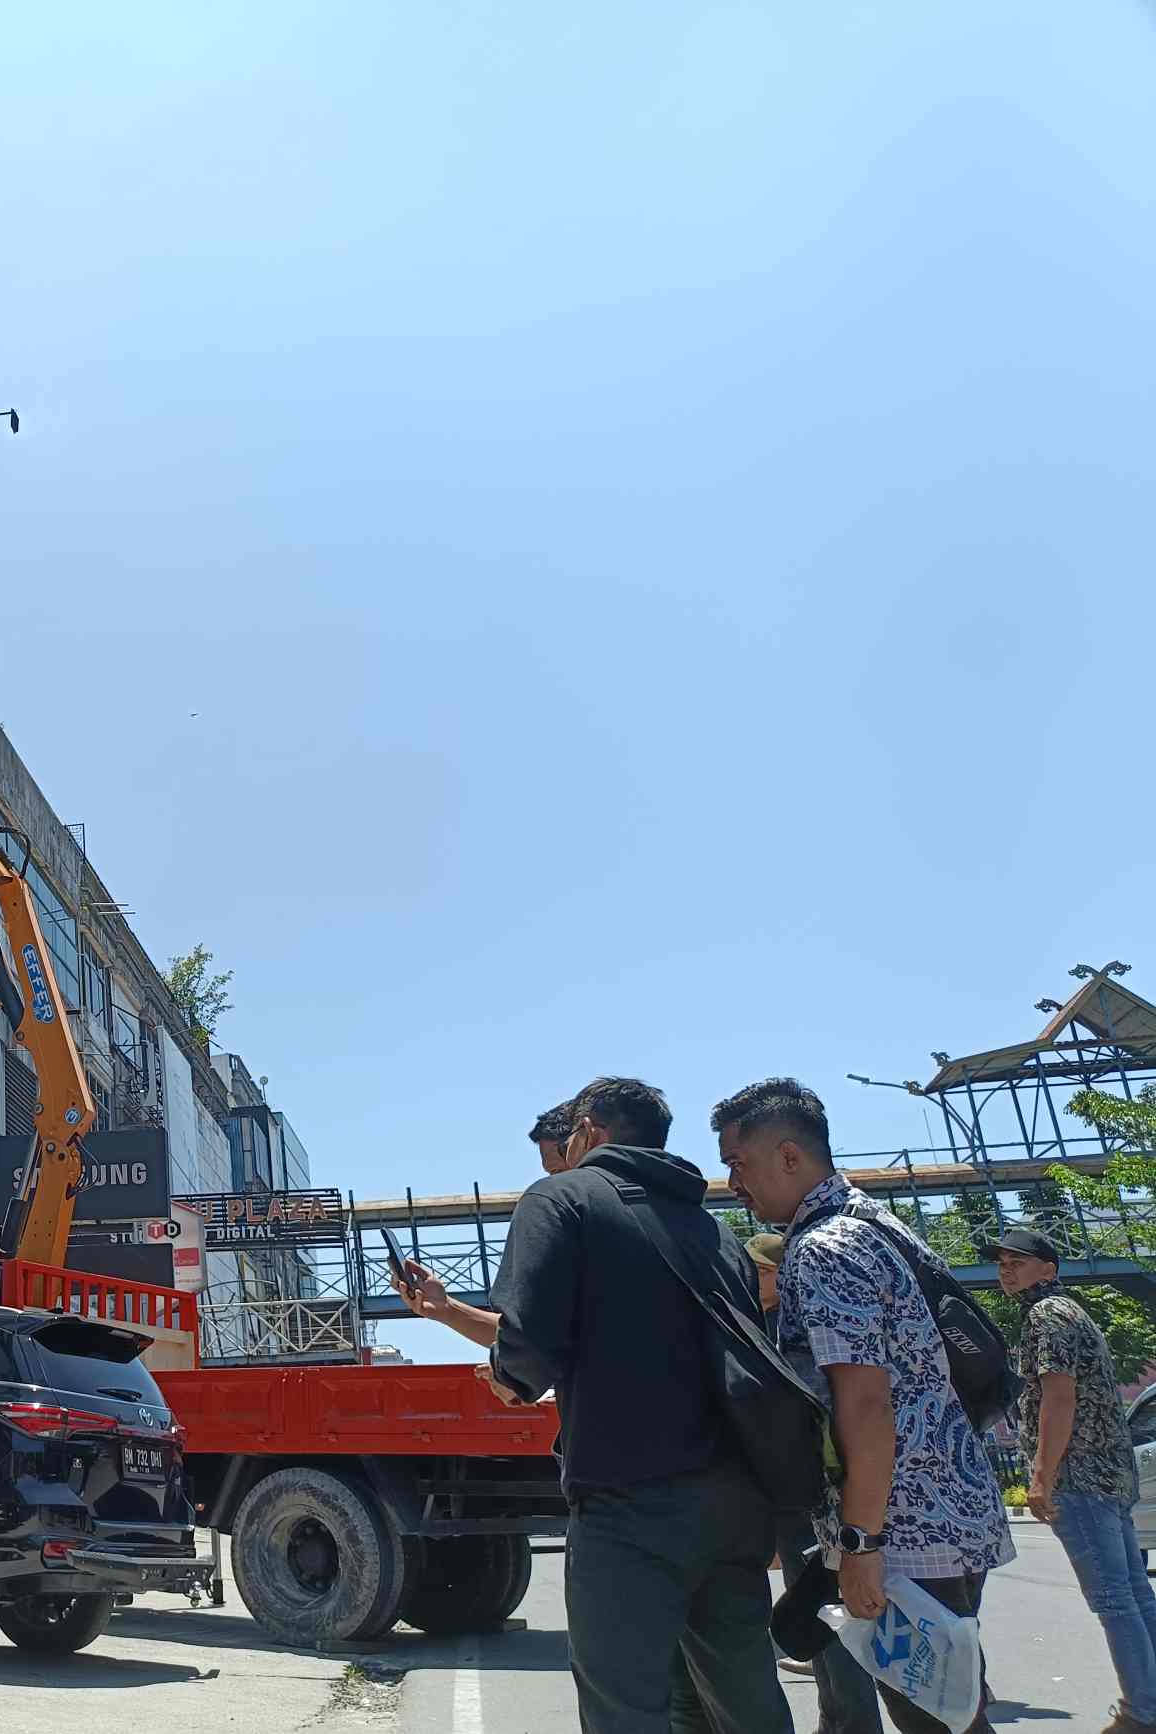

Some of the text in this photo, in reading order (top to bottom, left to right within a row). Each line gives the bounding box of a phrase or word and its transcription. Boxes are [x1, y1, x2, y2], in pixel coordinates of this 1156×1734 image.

[227, 1197, 328, 1224] PLAZA
[216, 1225, 275, 1240] DIGITAL
[136, 1449, 149, 1467] 732
